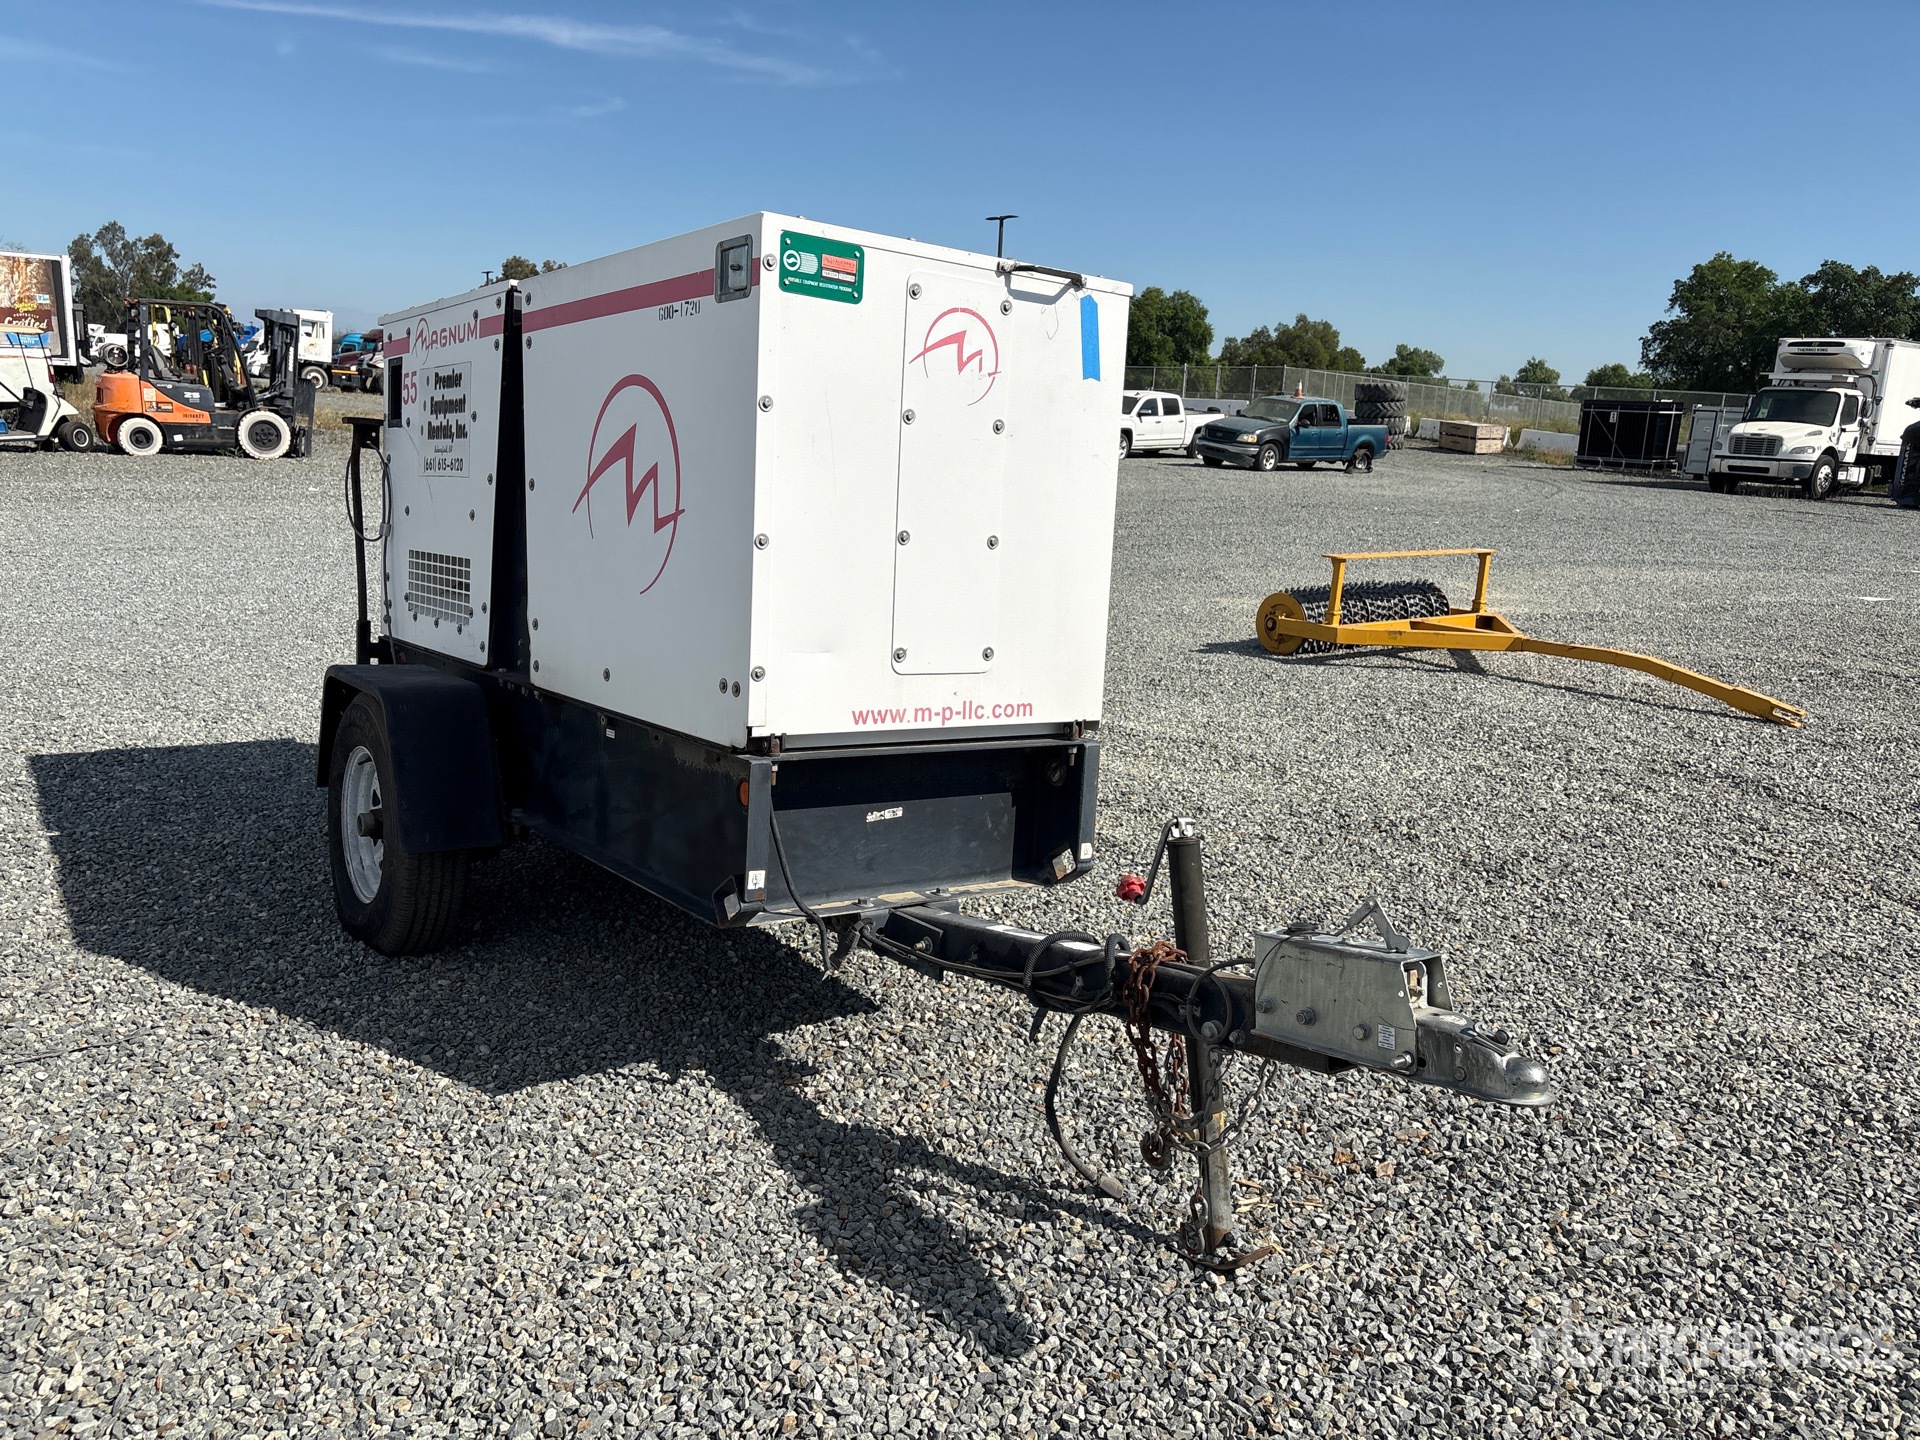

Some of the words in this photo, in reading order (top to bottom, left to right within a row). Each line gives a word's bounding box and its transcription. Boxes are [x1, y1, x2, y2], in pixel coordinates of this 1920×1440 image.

[4, 317, 48, 329] Crafted
[411, 320, 478, 354] MAGNUM
[403, 370, 417, 405] 55
[434, 368, 462, 390] Premier
[430, 394, 466, 420] Equipment
[427, 419, 455, 443] Rentals,
[455, 419, 468, 439] Inc.
[423, 457, 437, 472] (661)
[437, 457, 464, 472] 615-6120
[852, 700, 1033, 726] www.m-p-llc.com
